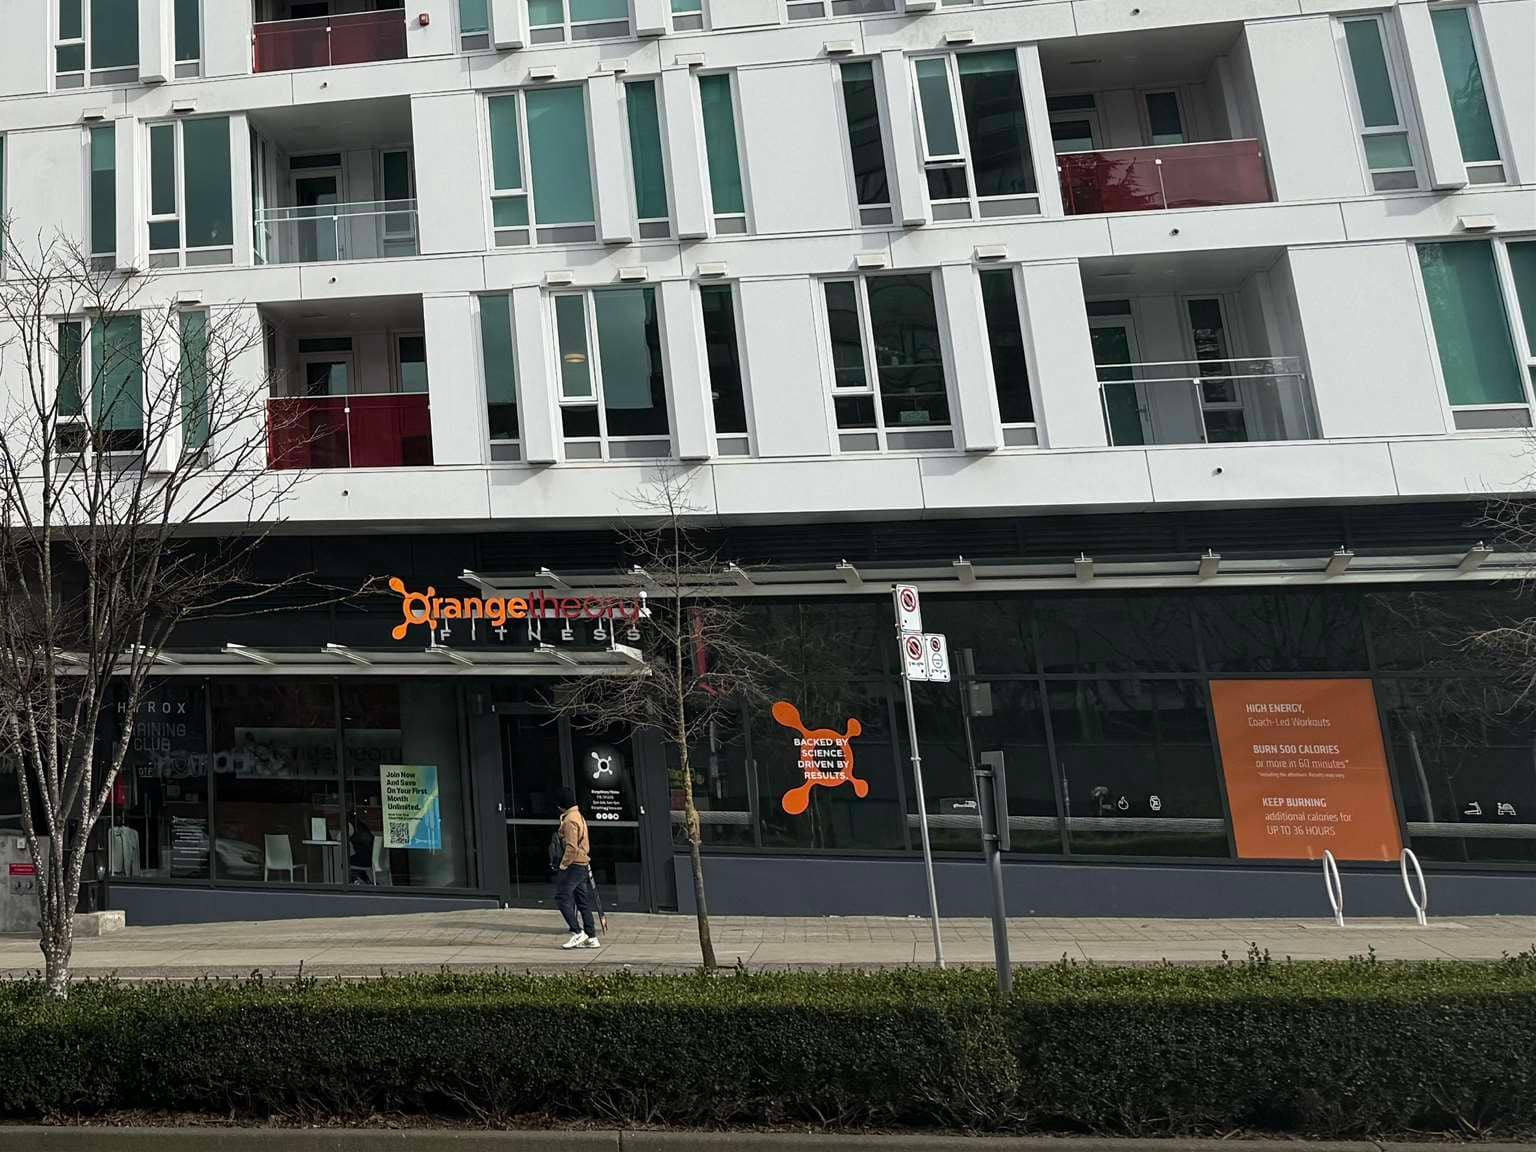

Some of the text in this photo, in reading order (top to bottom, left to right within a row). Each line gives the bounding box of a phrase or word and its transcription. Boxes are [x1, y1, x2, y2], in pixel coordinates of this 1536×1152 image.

[440, 628, 641, 641] FITNESS
[1246, 703, 1305, 714] HIGH ENERGY,
[134, 737, 171, 752] CLUB
[793, 738, 849, 746] BACKED BY
[1253, 744, 1340, 754] BURN 500 CALORIES
[797, 760, 849, 768] DRIVEN BY
[1266, 759, 1287, 768] more
[804, 771, 849, 780] RESULTS.
[1262, 797, 1327, 808] KEEP BURNING
[1265, 811, 1306, 822] additional
[1307, 811, 1339, 822] calories
[1267, 825, 1336, 836] UP TO 36 HOURS
